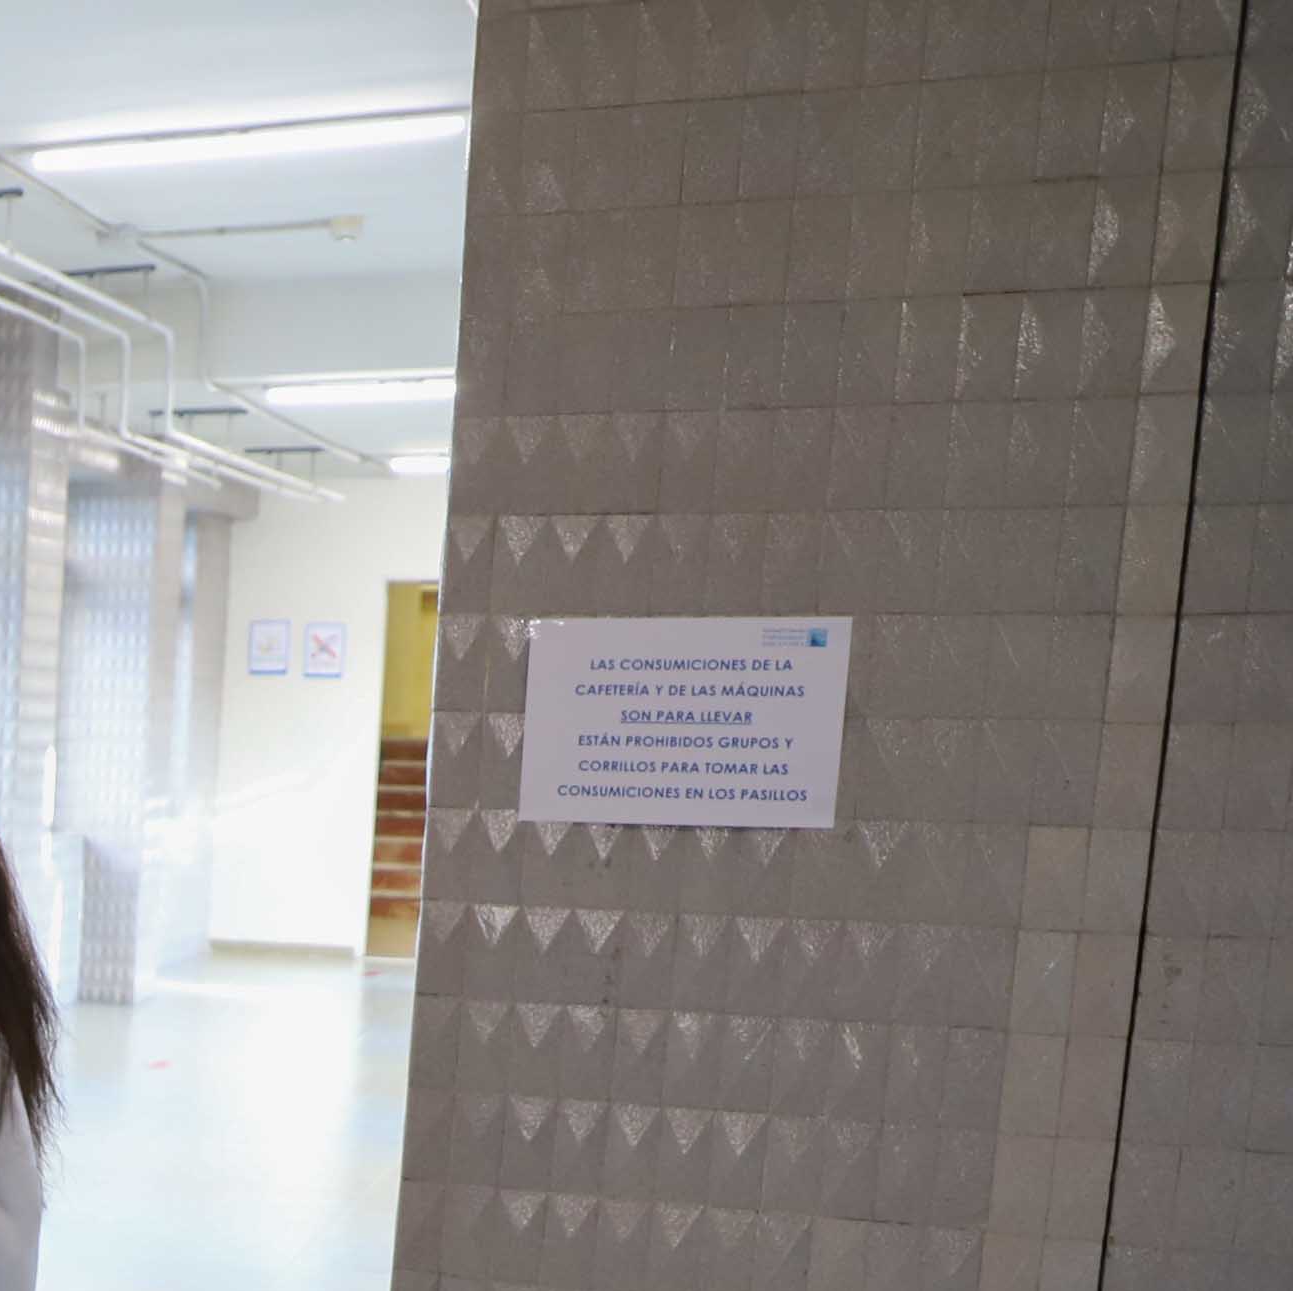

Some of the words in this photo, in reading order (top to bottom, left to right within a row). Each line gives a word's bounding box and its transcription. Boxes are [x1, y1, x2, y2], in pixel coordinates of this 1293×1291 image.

[590, 659, 615, 671] LAS
[620, 659, 747, 672] CONSUMICIONES
[751, 659, 773, 672] DE
[775, 659, 793, 672] LA
[575, 681, 650, 696] CAFETERÍA
[656, 684, 664, 696] Y
[668, 684, 687, 696] DE
[691, 684, 717, 697] LAS
[721, 681, 805, 698] MÁQUINAS
[620, 709, 652, 722] SON
[656, 709, 695, 723] PARA
[700, 711, 753, 724] LLEVAR
[578, 731, 621, 747] ESTÁN
[625, 735, 714, 749] PROHIBIDOS
[718, 736, 779, 750] GRUPOS
[785, 737, 794, 750] Y
[578, 760, 656, 773] CORRILLOS
[661, 761, 700, 773] PARA
[705, 762, 758, 775] TOMAR
[763, 763, 789, 775] LAS
[557, 784, 680, 799] CONSUMICIONES
[685, 786, 704, 800] EN
[708, 788, 735, 801] LOS
[740, 788, 808, 802] PASILLOS
